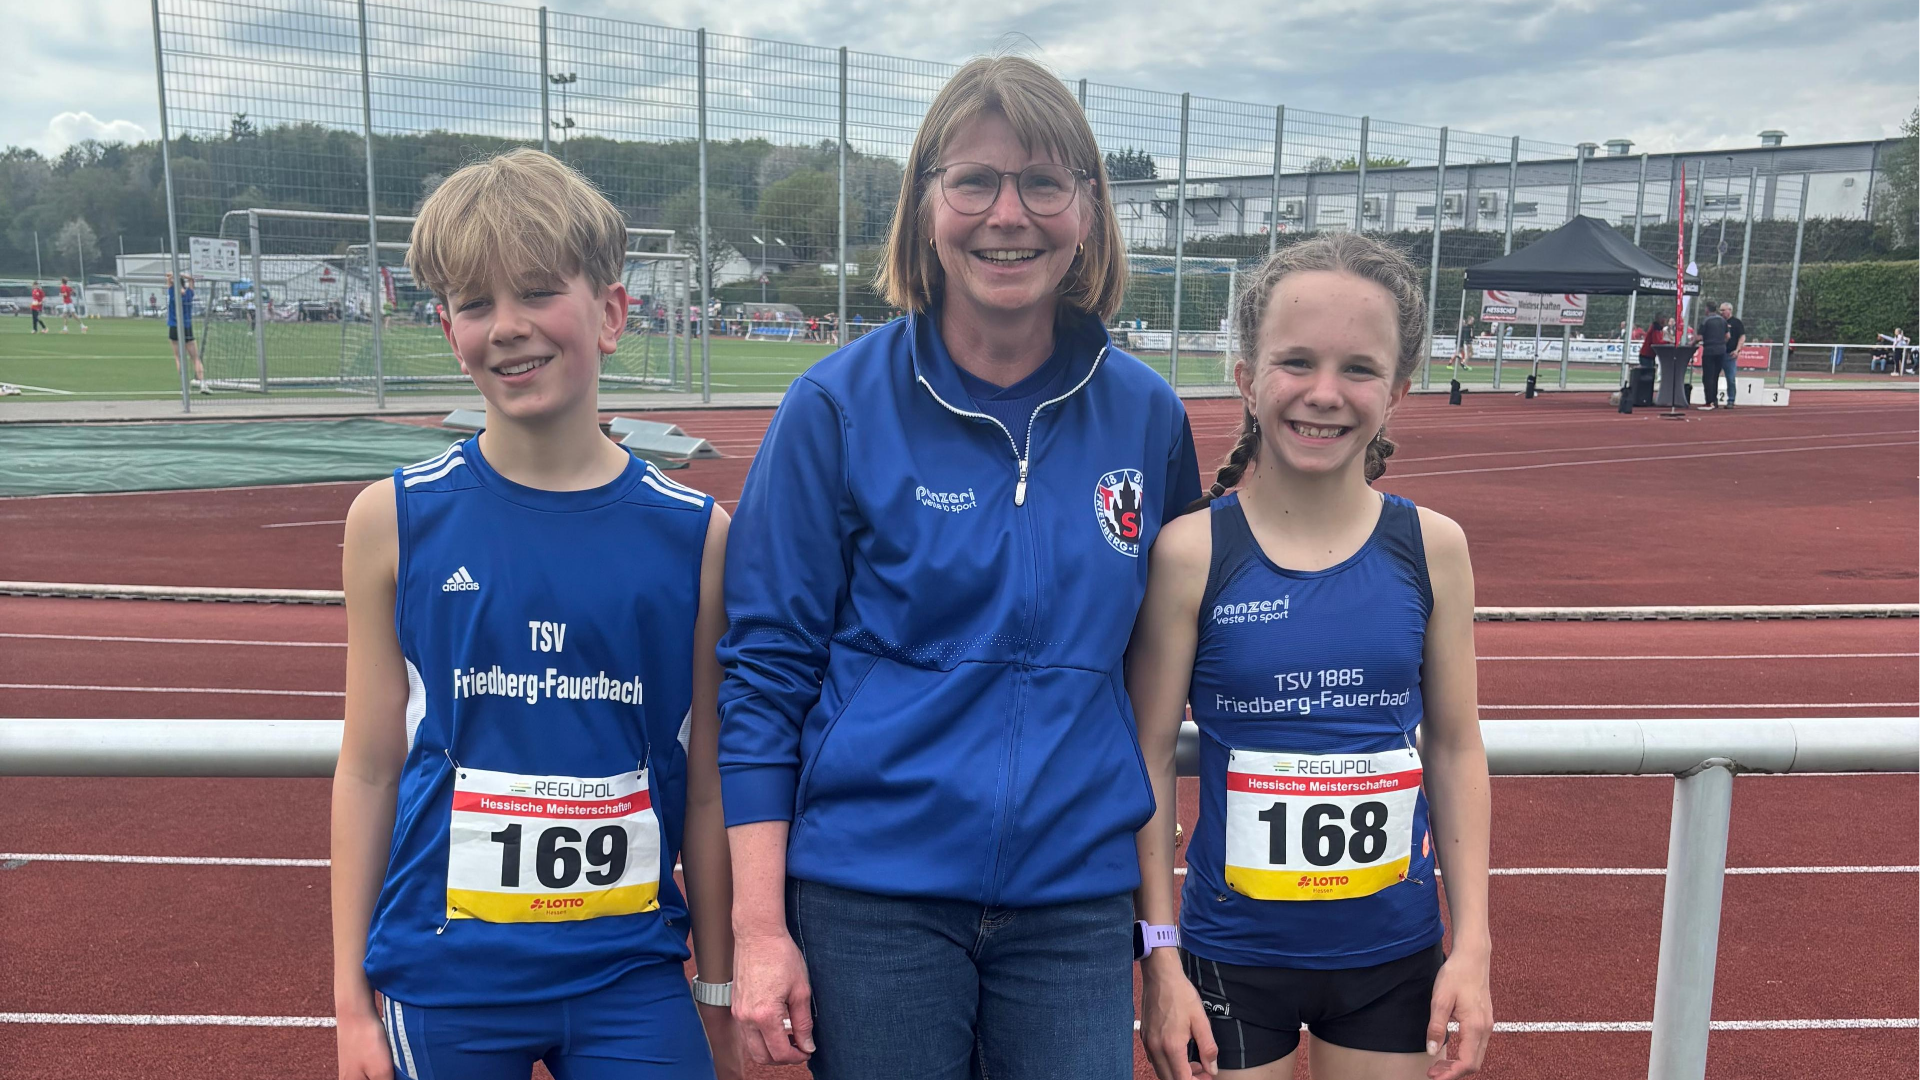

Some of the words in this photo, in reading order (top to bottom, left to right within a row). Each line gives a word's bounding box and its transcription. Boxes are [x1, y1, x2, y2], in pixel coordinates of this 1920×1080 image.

[1719, 391, 1725, 402] 2
[1748, 383, 1752, 394] 1
[1772, 392, 1779, 403] 3
[950, 500, 978, 514] sport
[442, 582, 480, 592] adidas
[1212, 594, 1290, 620] panzeri
[1216, 614, 1245, 625] veste
[1247, 613, 1257, 623] lo
[1259, 609, 1289, 624] sport
[528, 620, 566, 652] TSV
[453, 664, 643, 705] Friedberg-Fauerbach
[1274, 671, 1312, 692] TSV
[1316, 668, 1364, 689] 1885
[1215, 687, 1410, 716] Friedberg-Fauerbach
[1297, 758, 1377, 775] REGUPOL
[534, 780, 615, 799] REGUPOL
[1248, 777, 1306, 791] Hessische
[1309, 777, 1399, 792] Meisterschaften
[480, 797, 544, 813] Hessische
[546, 800, 632, 816] Meisterschaften
[1258, 801, 1389, 867] 168
[490, 823, 628, 889] 169
[1313, 875, 1349, 887] LOTTO
[546, 897, 585, 909] LOTTO
